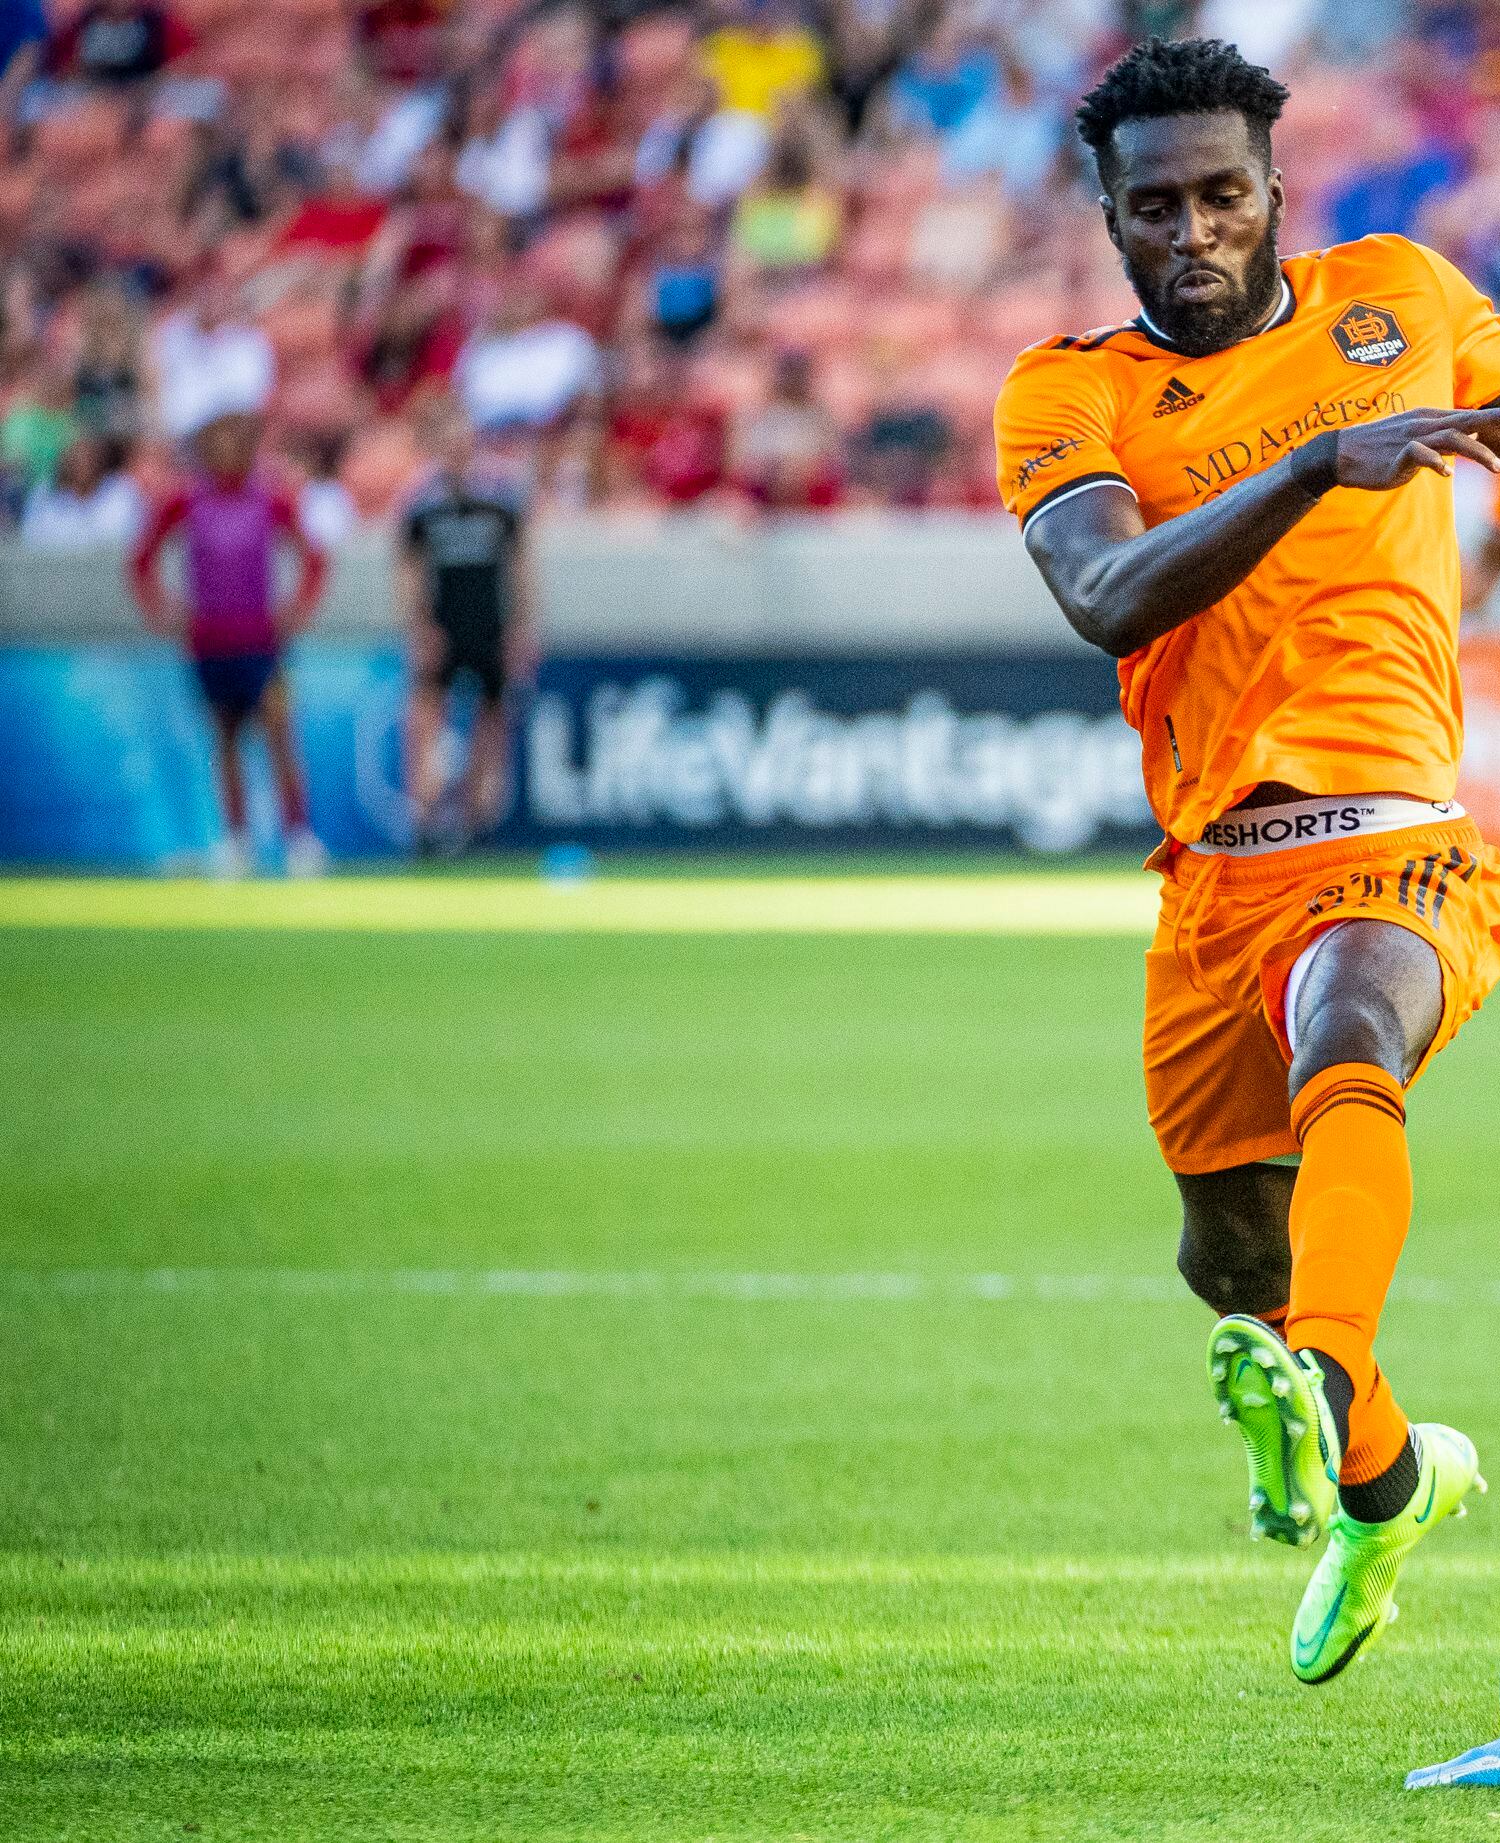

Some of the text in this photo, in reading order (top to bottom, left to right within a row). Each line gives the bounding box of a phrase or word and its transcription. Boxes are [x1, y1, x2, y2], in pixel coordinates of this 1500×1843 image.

[1346, 338, 1404, 360] HOUSTON
[1152, 392, 1206, 419] adidas
[1180, 390, 1406, 497] MD Anderson
